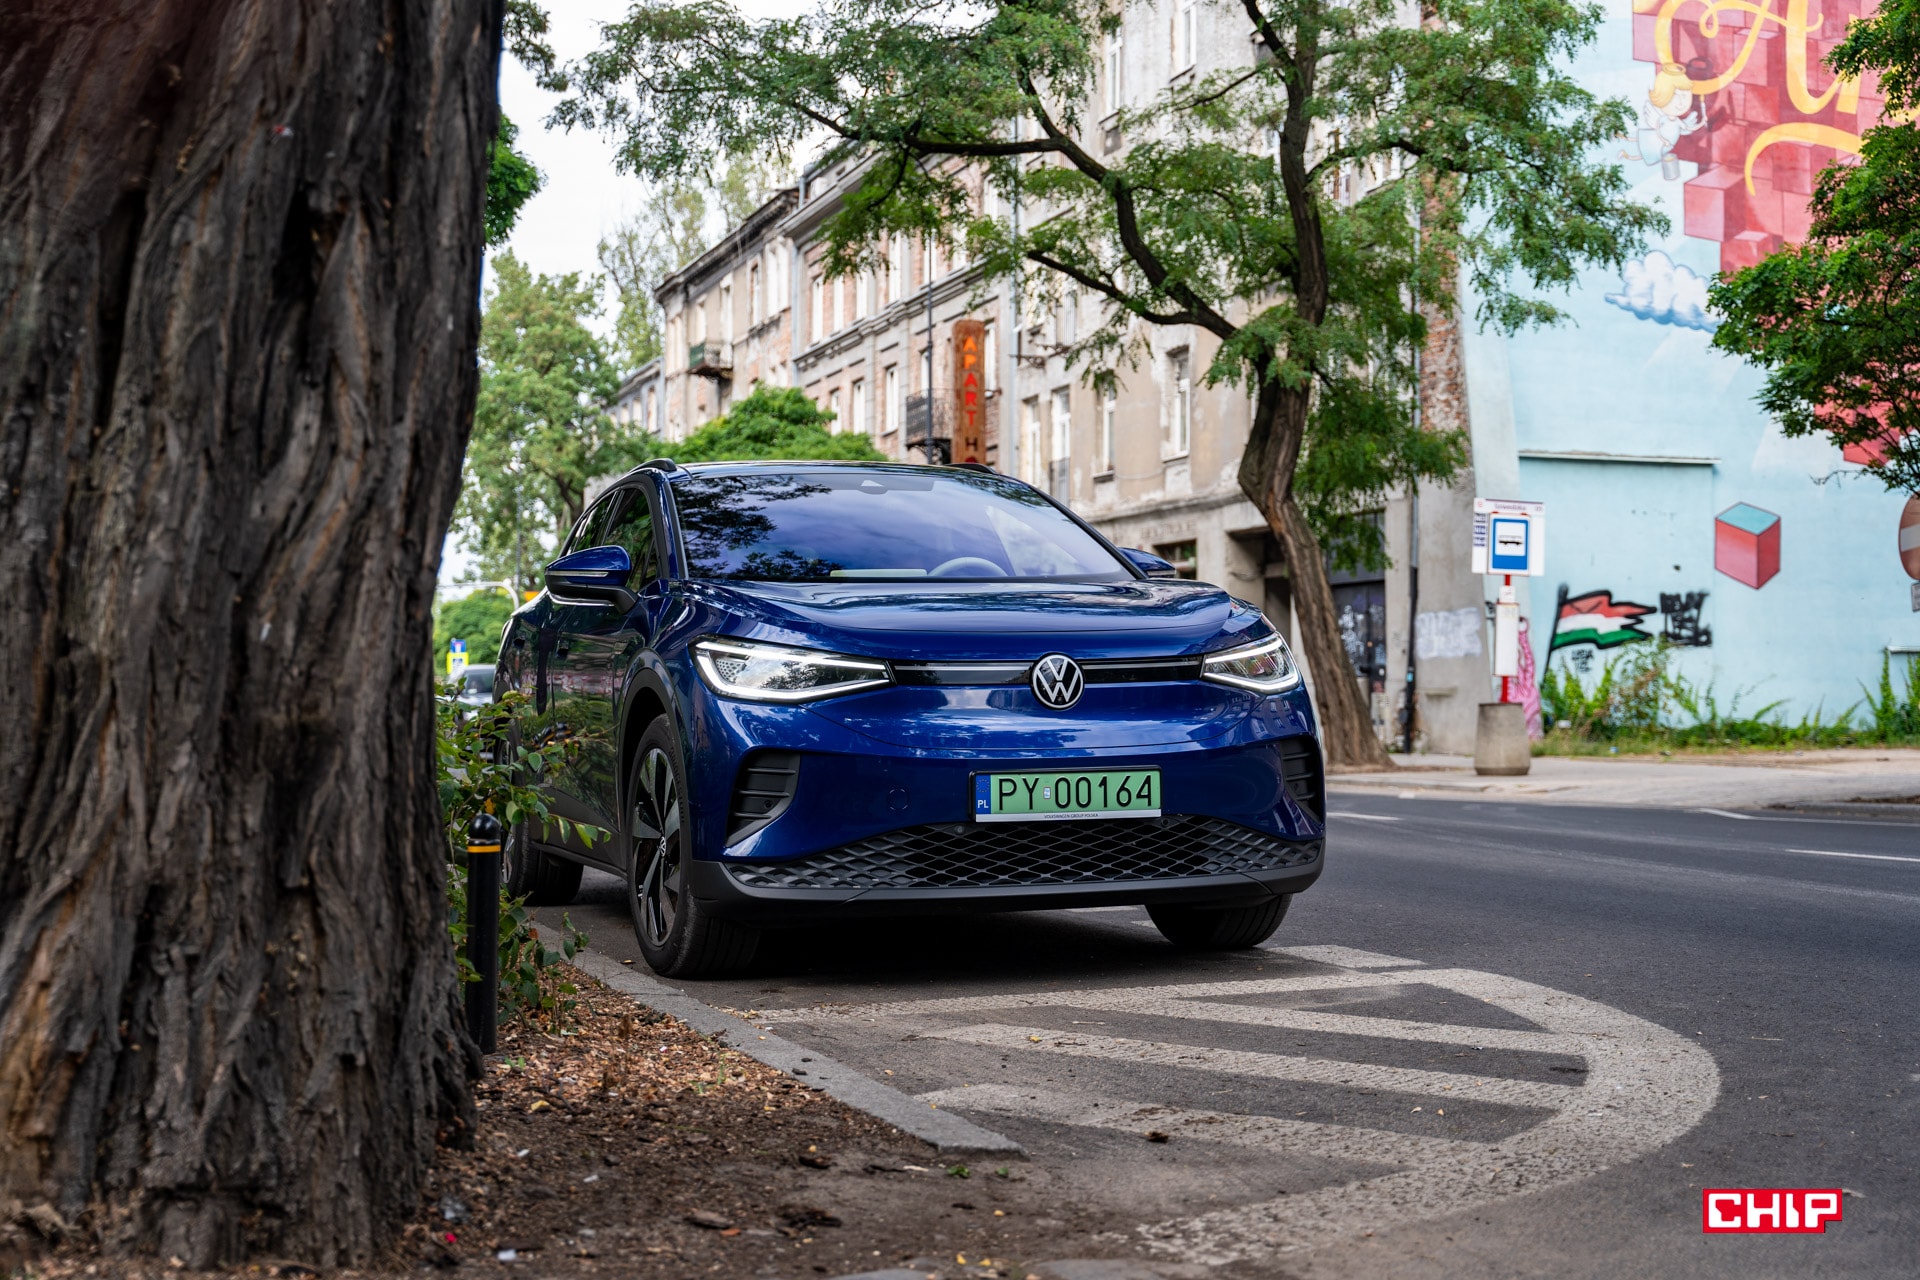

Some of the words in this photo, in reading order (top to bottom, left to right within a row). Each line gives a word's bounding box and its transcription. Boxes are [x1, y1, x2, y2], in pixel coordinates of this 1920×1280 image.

[963, 336, 978, 426] APART
[1034, 655, 1083, 708] VW
[977, 799, 989, 809] PL
[998, 777, 1040, 811] PY
[1054, 774, 1153, 809] 00164
